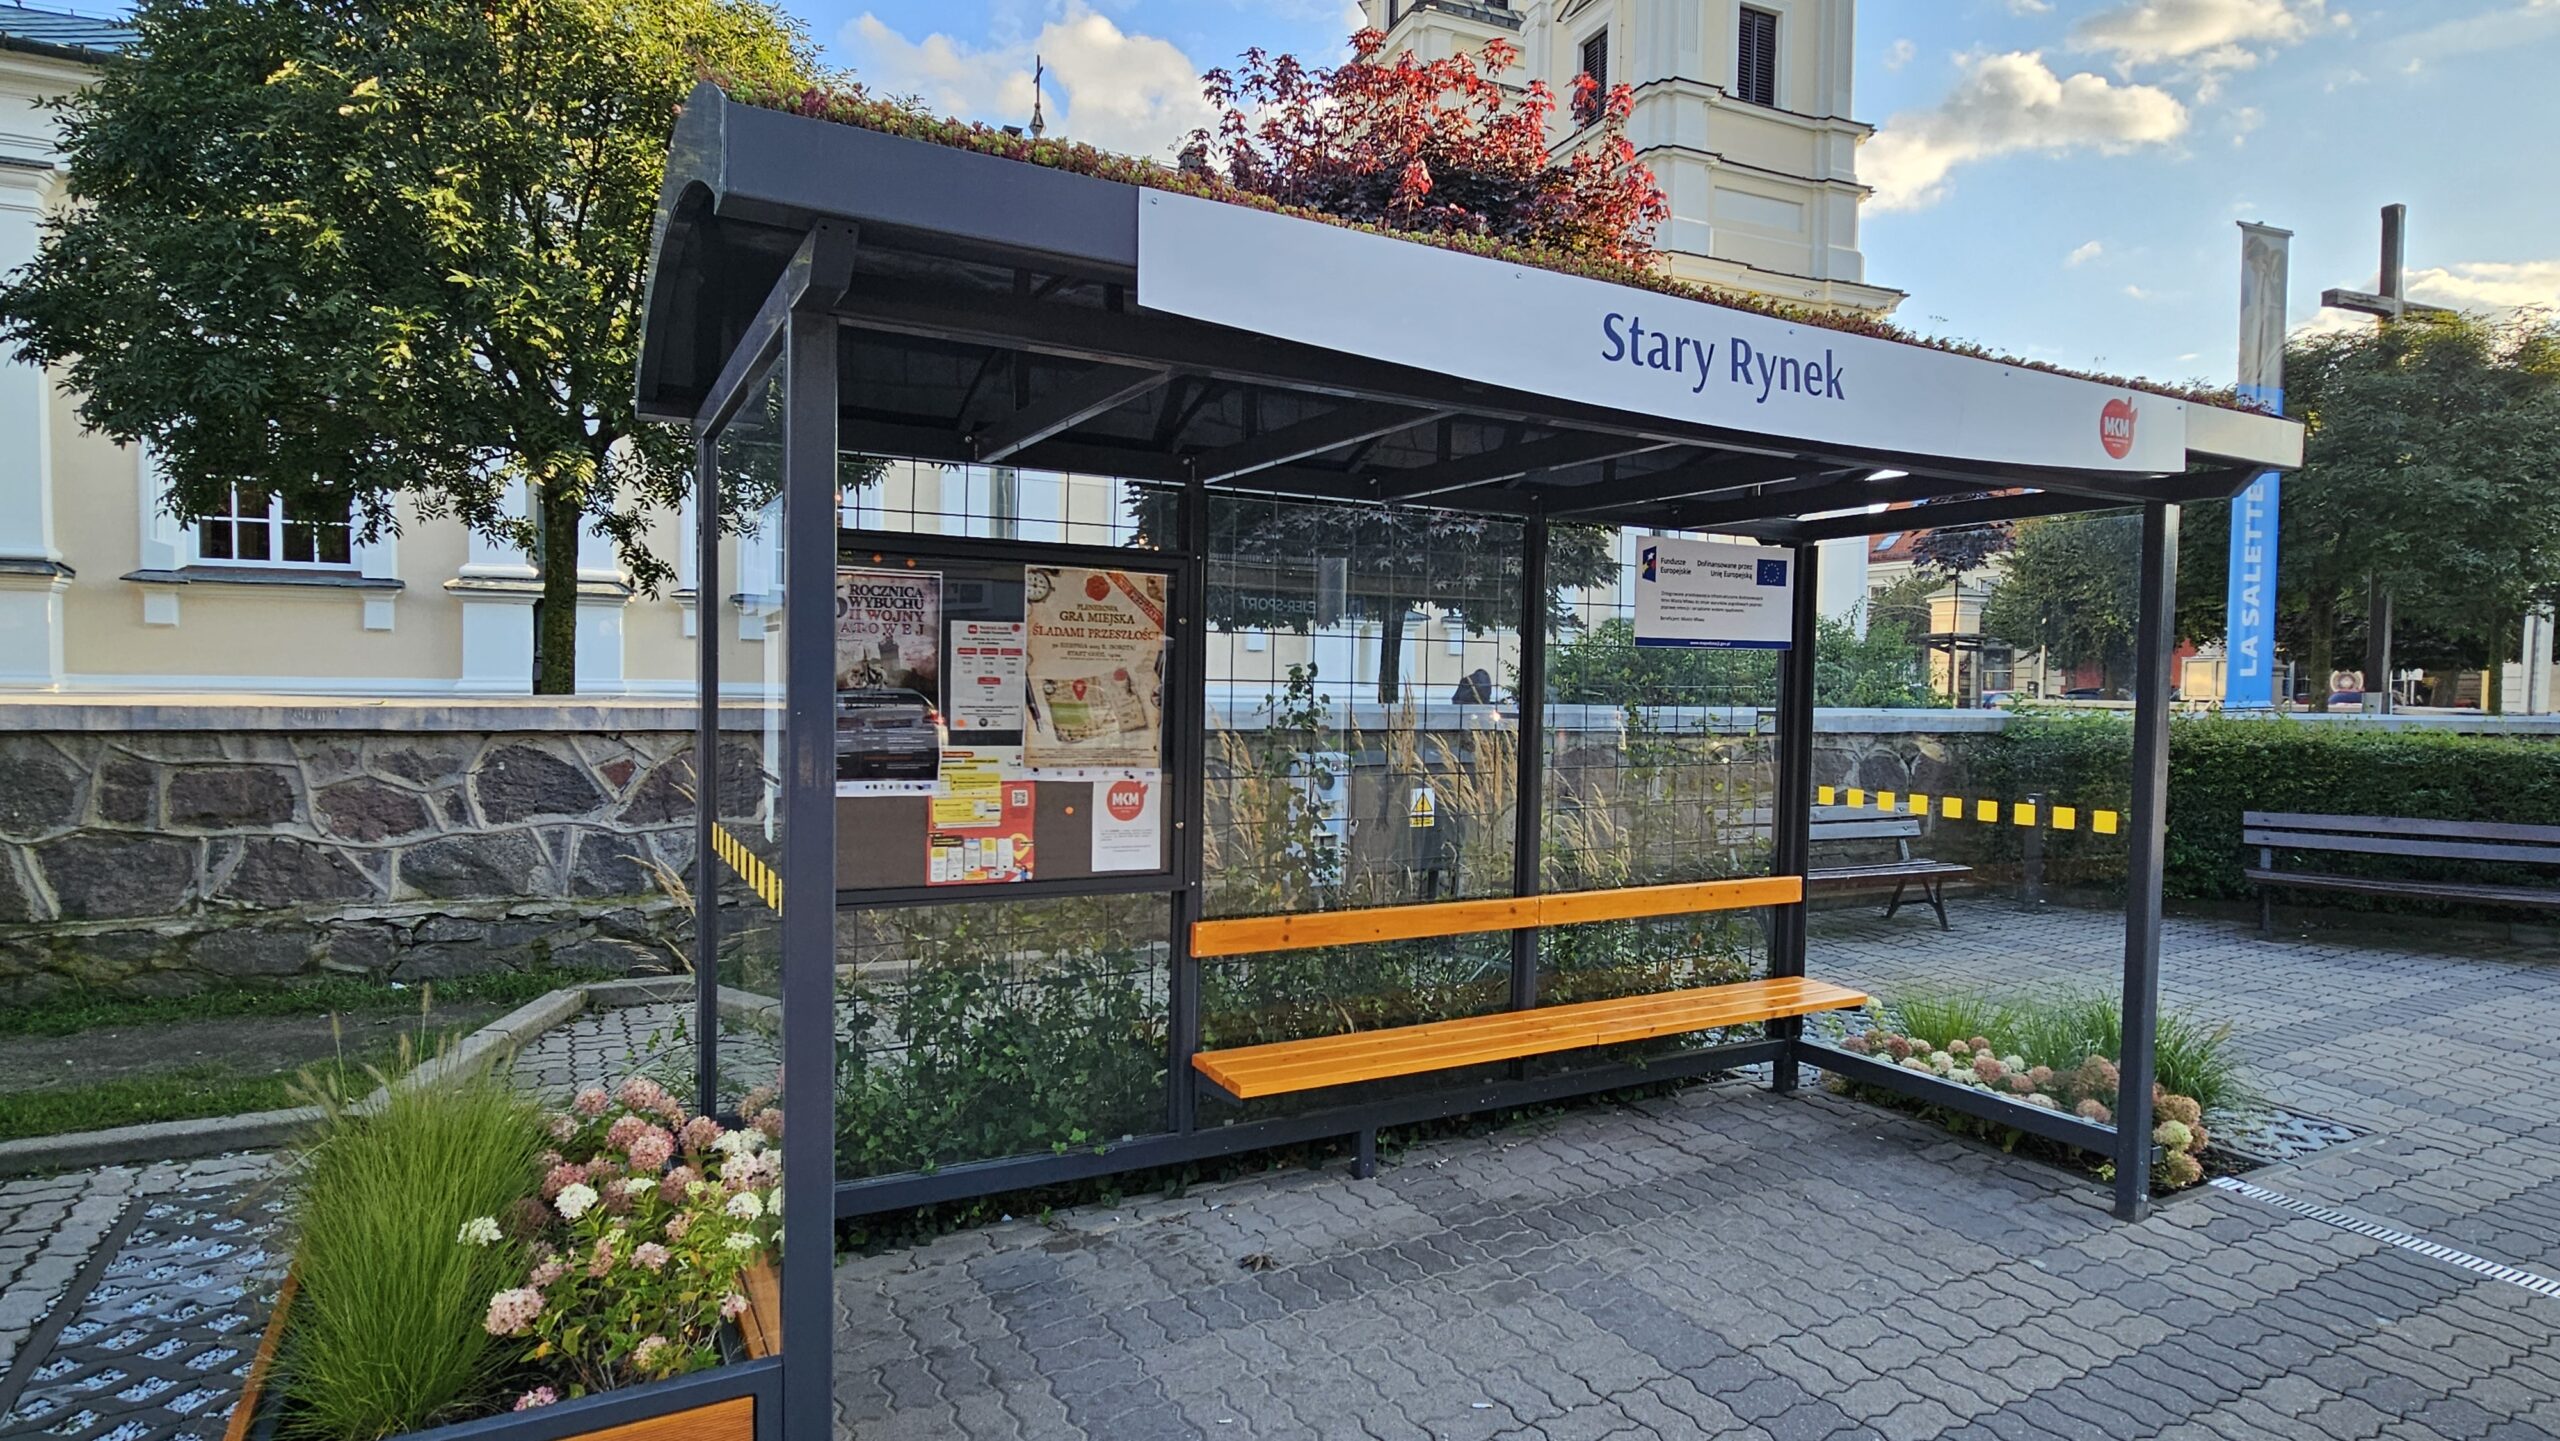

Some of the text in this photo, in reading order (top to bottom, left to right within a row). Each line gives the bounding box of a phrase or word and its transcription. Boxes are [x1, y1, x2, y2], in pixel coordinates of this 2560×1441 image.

[1601, 312, 1845, 404] Stary Rynek
[2104, 416, 2130, 437] MKM
[1660, 557, 1687, 566] Fundusze
[1660, 566, 1692, 576] Europejskie
[2240, 484, 2264, 677] LA SALETTE
[849, 584, 924, 598] ROCZNICA
[848, 596, 924, 610] WYBUCHU
[849, 608, 924, 622] II WOJNY
[1060, 610, 1135, 626] GRA MIEJSKA
[840, 622, 924, 636] ATOWEJ
[1032, 622, 1085, 638] ŚLADAMI
[1112, 792, 1140, 806] MKM
